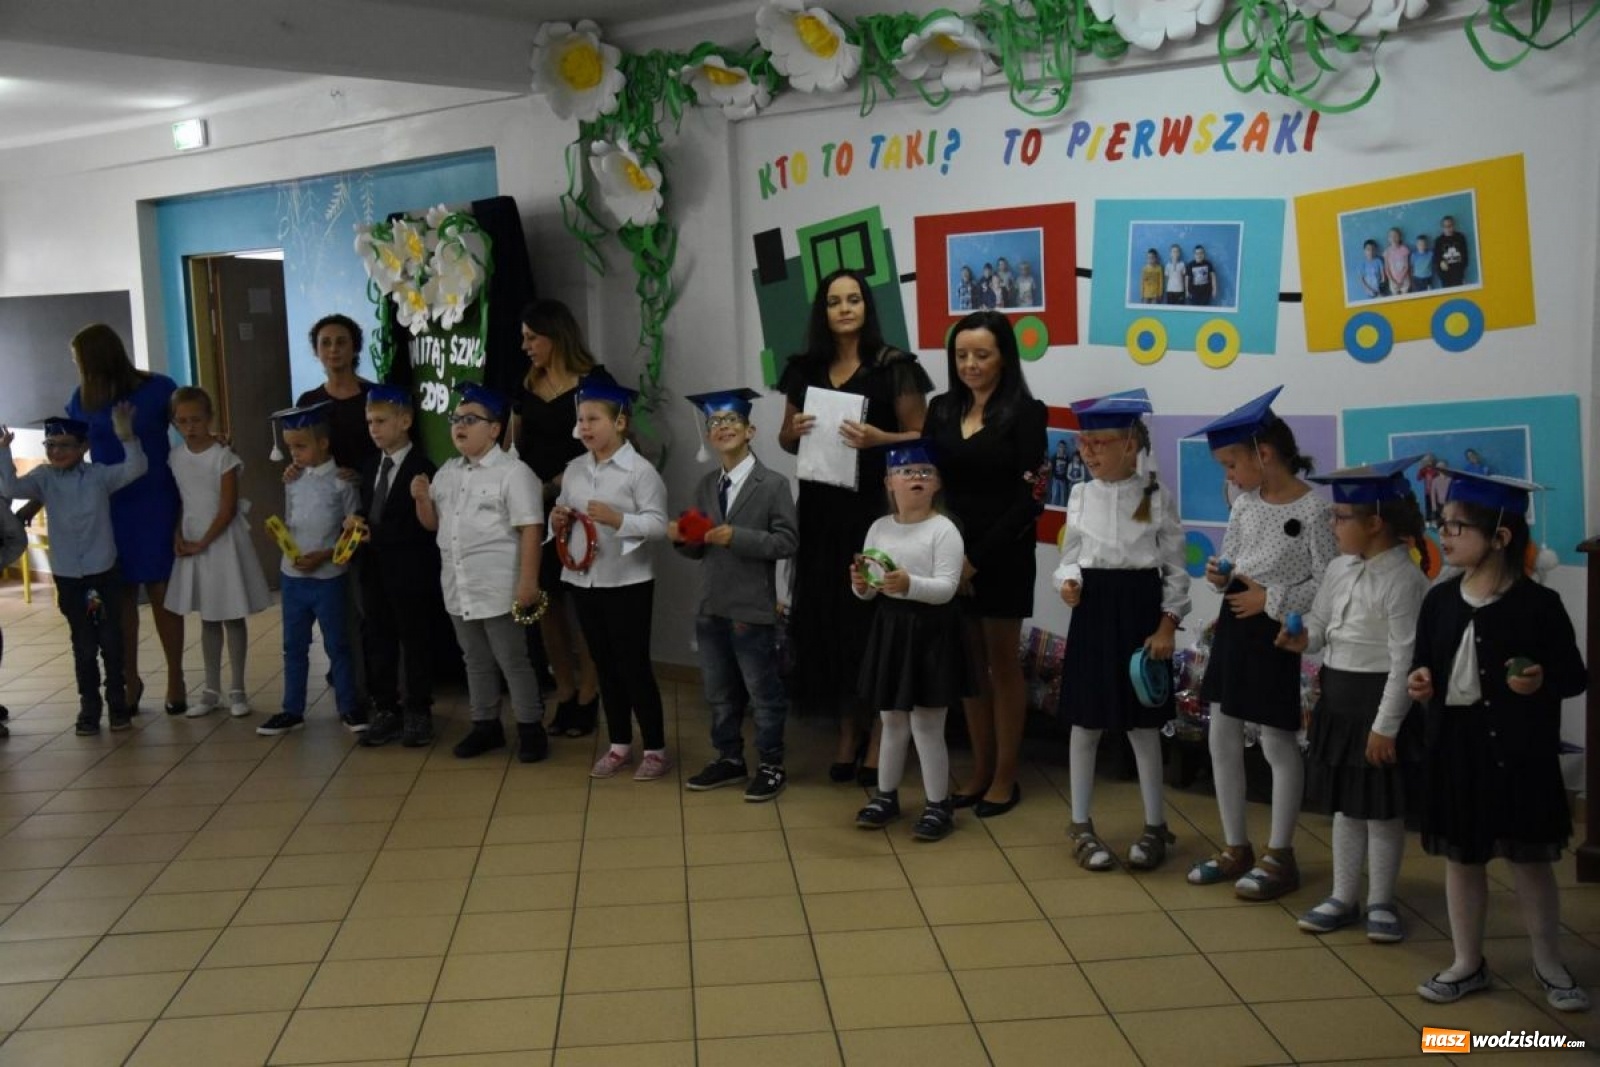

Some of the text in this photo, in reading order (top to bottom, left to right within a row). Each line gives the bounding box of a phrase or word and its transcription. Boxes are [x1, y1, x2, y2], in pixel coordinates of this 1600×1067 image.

[759, 110, 1320, 200] KTO TO TAKI? TO PIERWSZAKI
